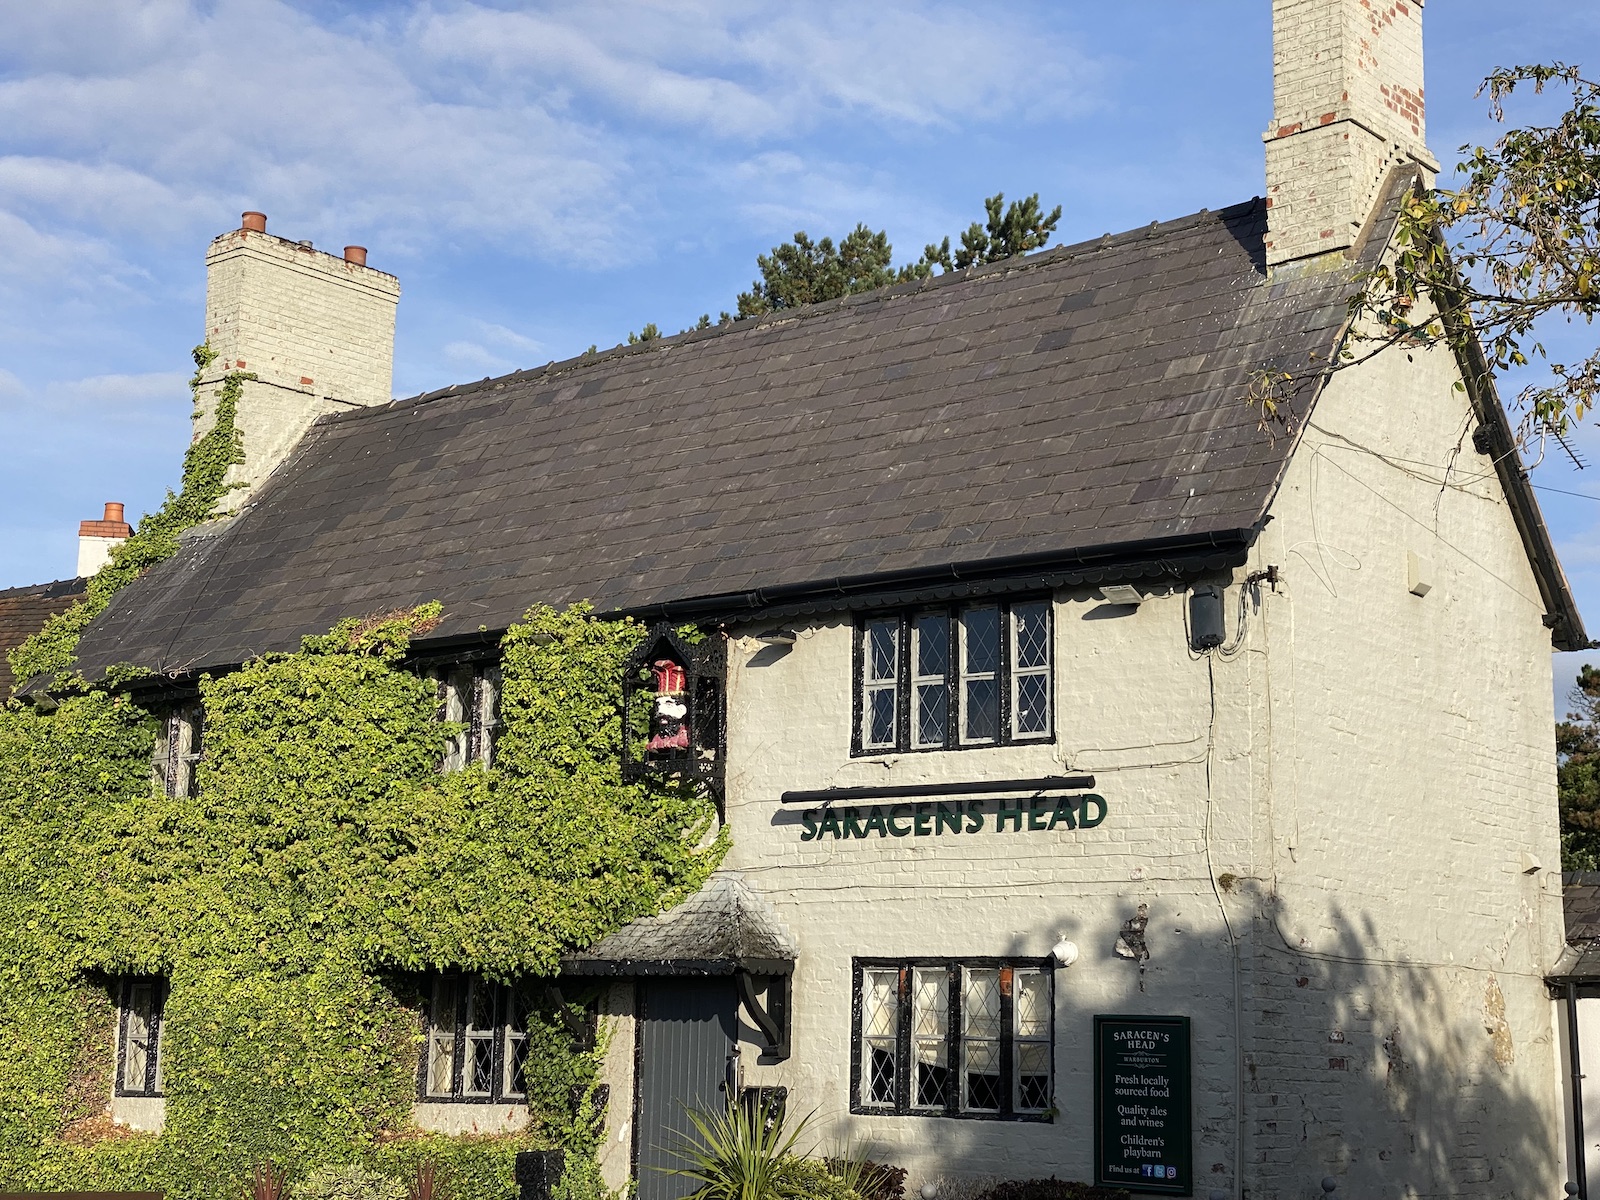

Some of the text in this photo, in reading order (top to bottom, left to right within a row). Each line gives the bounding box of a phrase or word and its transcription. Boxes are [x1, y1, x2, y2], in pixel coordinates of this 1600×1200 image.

[800, 793, 1109, 842] SARACENS HEAD
[1113, 1030, 1170, 1043] SARACEN'S
[1127, 1040, 1156, 1050] HEAD
[1115, 1074, 1169, 1088] Fresh locally
[1114, 1086, 1170, 1098] sourced food
[1117, 1104, 1167, 1117] Quality ales
[1120, 1116, 1164, 1128] and wines
[1120, 1134, 1165, 1147] Children's
[1123, 1146, 1162, 1159] playbarn
[1109, 1164, 1124, 1173] Find
